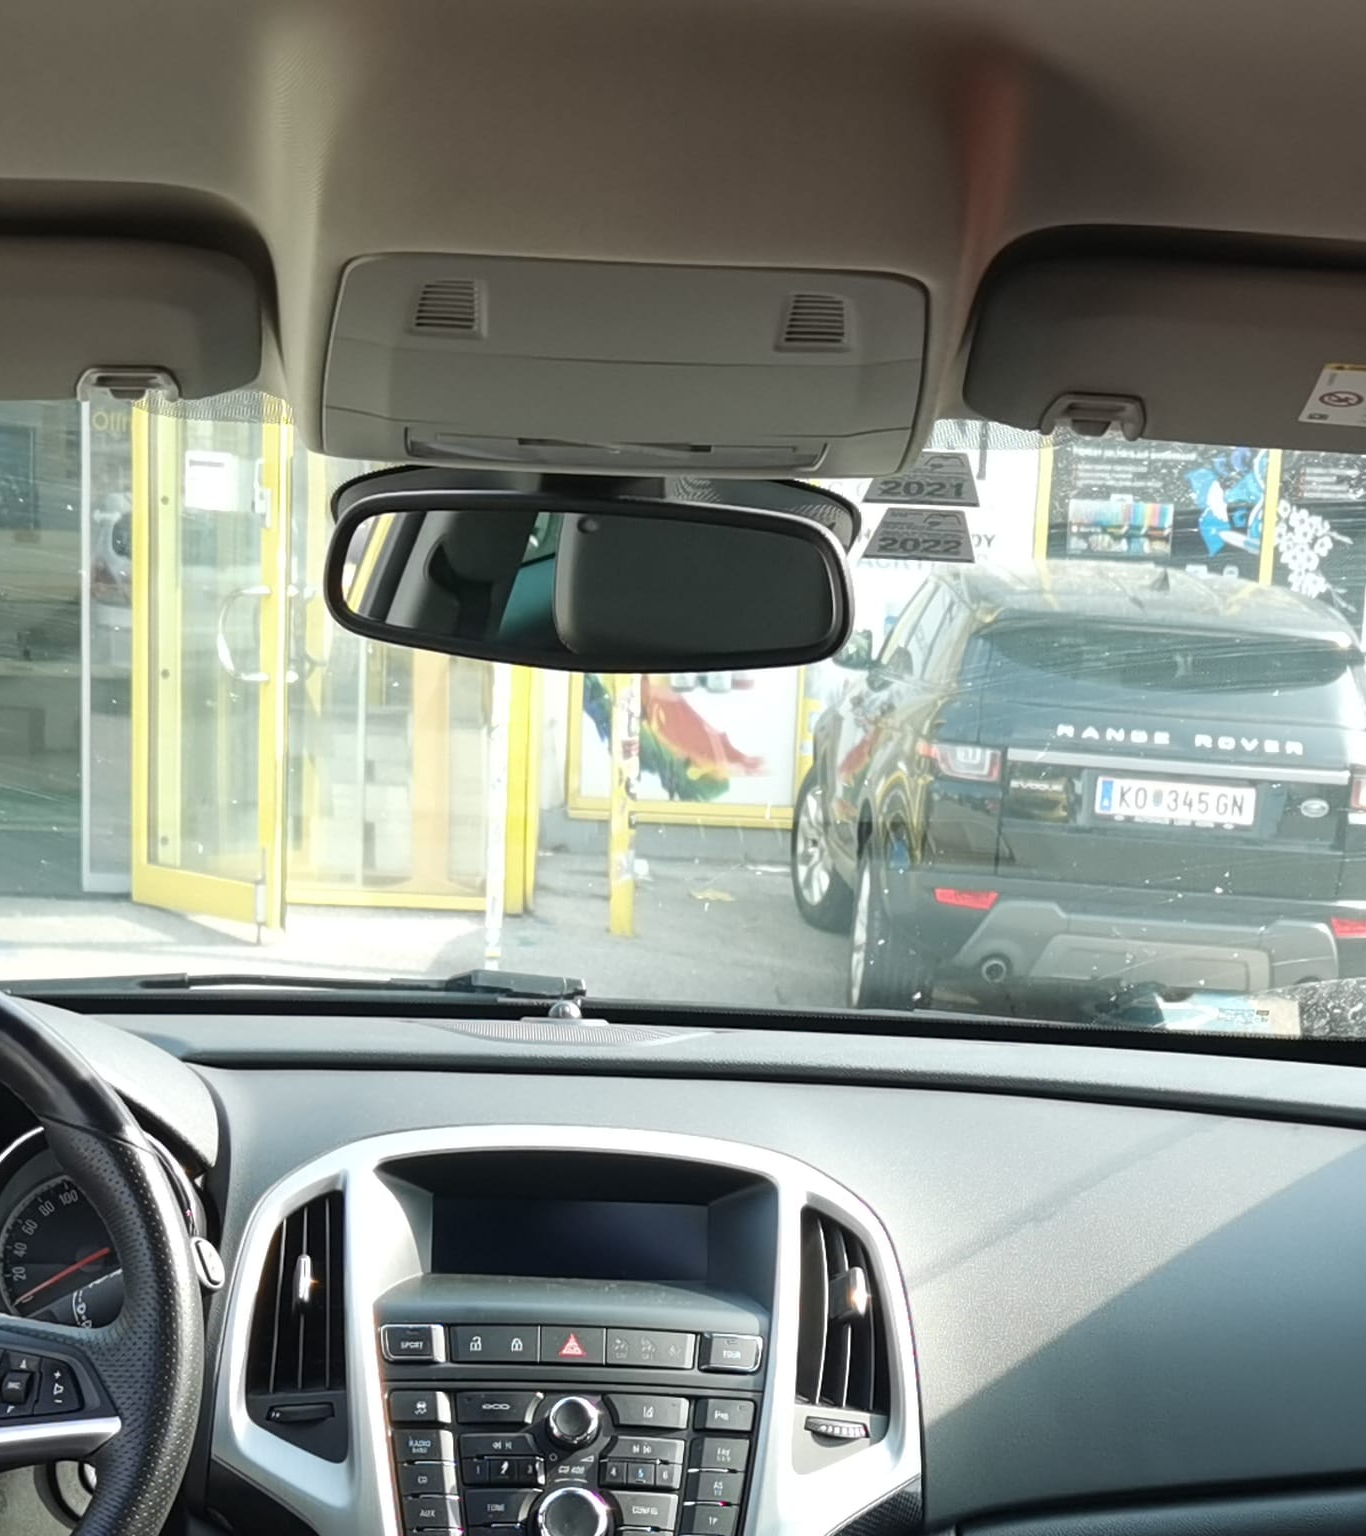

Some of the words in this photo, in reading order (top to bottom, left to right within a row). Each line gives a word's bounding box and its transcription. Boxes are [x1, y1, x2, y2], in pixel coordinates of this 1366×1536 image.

[879, 480, 964, 497] 2021
[878, 537, 963, 553] 2022
[1057, 724, 1170, 745] RANGE
[1195, 734, 1303, 755] ROVER
[59, 1190, 79, 1205] 100
[38, 1201, 55, 1217] 80
[22, 1219, 38, 1236] 60
[13, 1242, 27, 1258] 40
[13, 1266, 26, 1281] 20
[400, 1341, 424, 1349] SPORT
